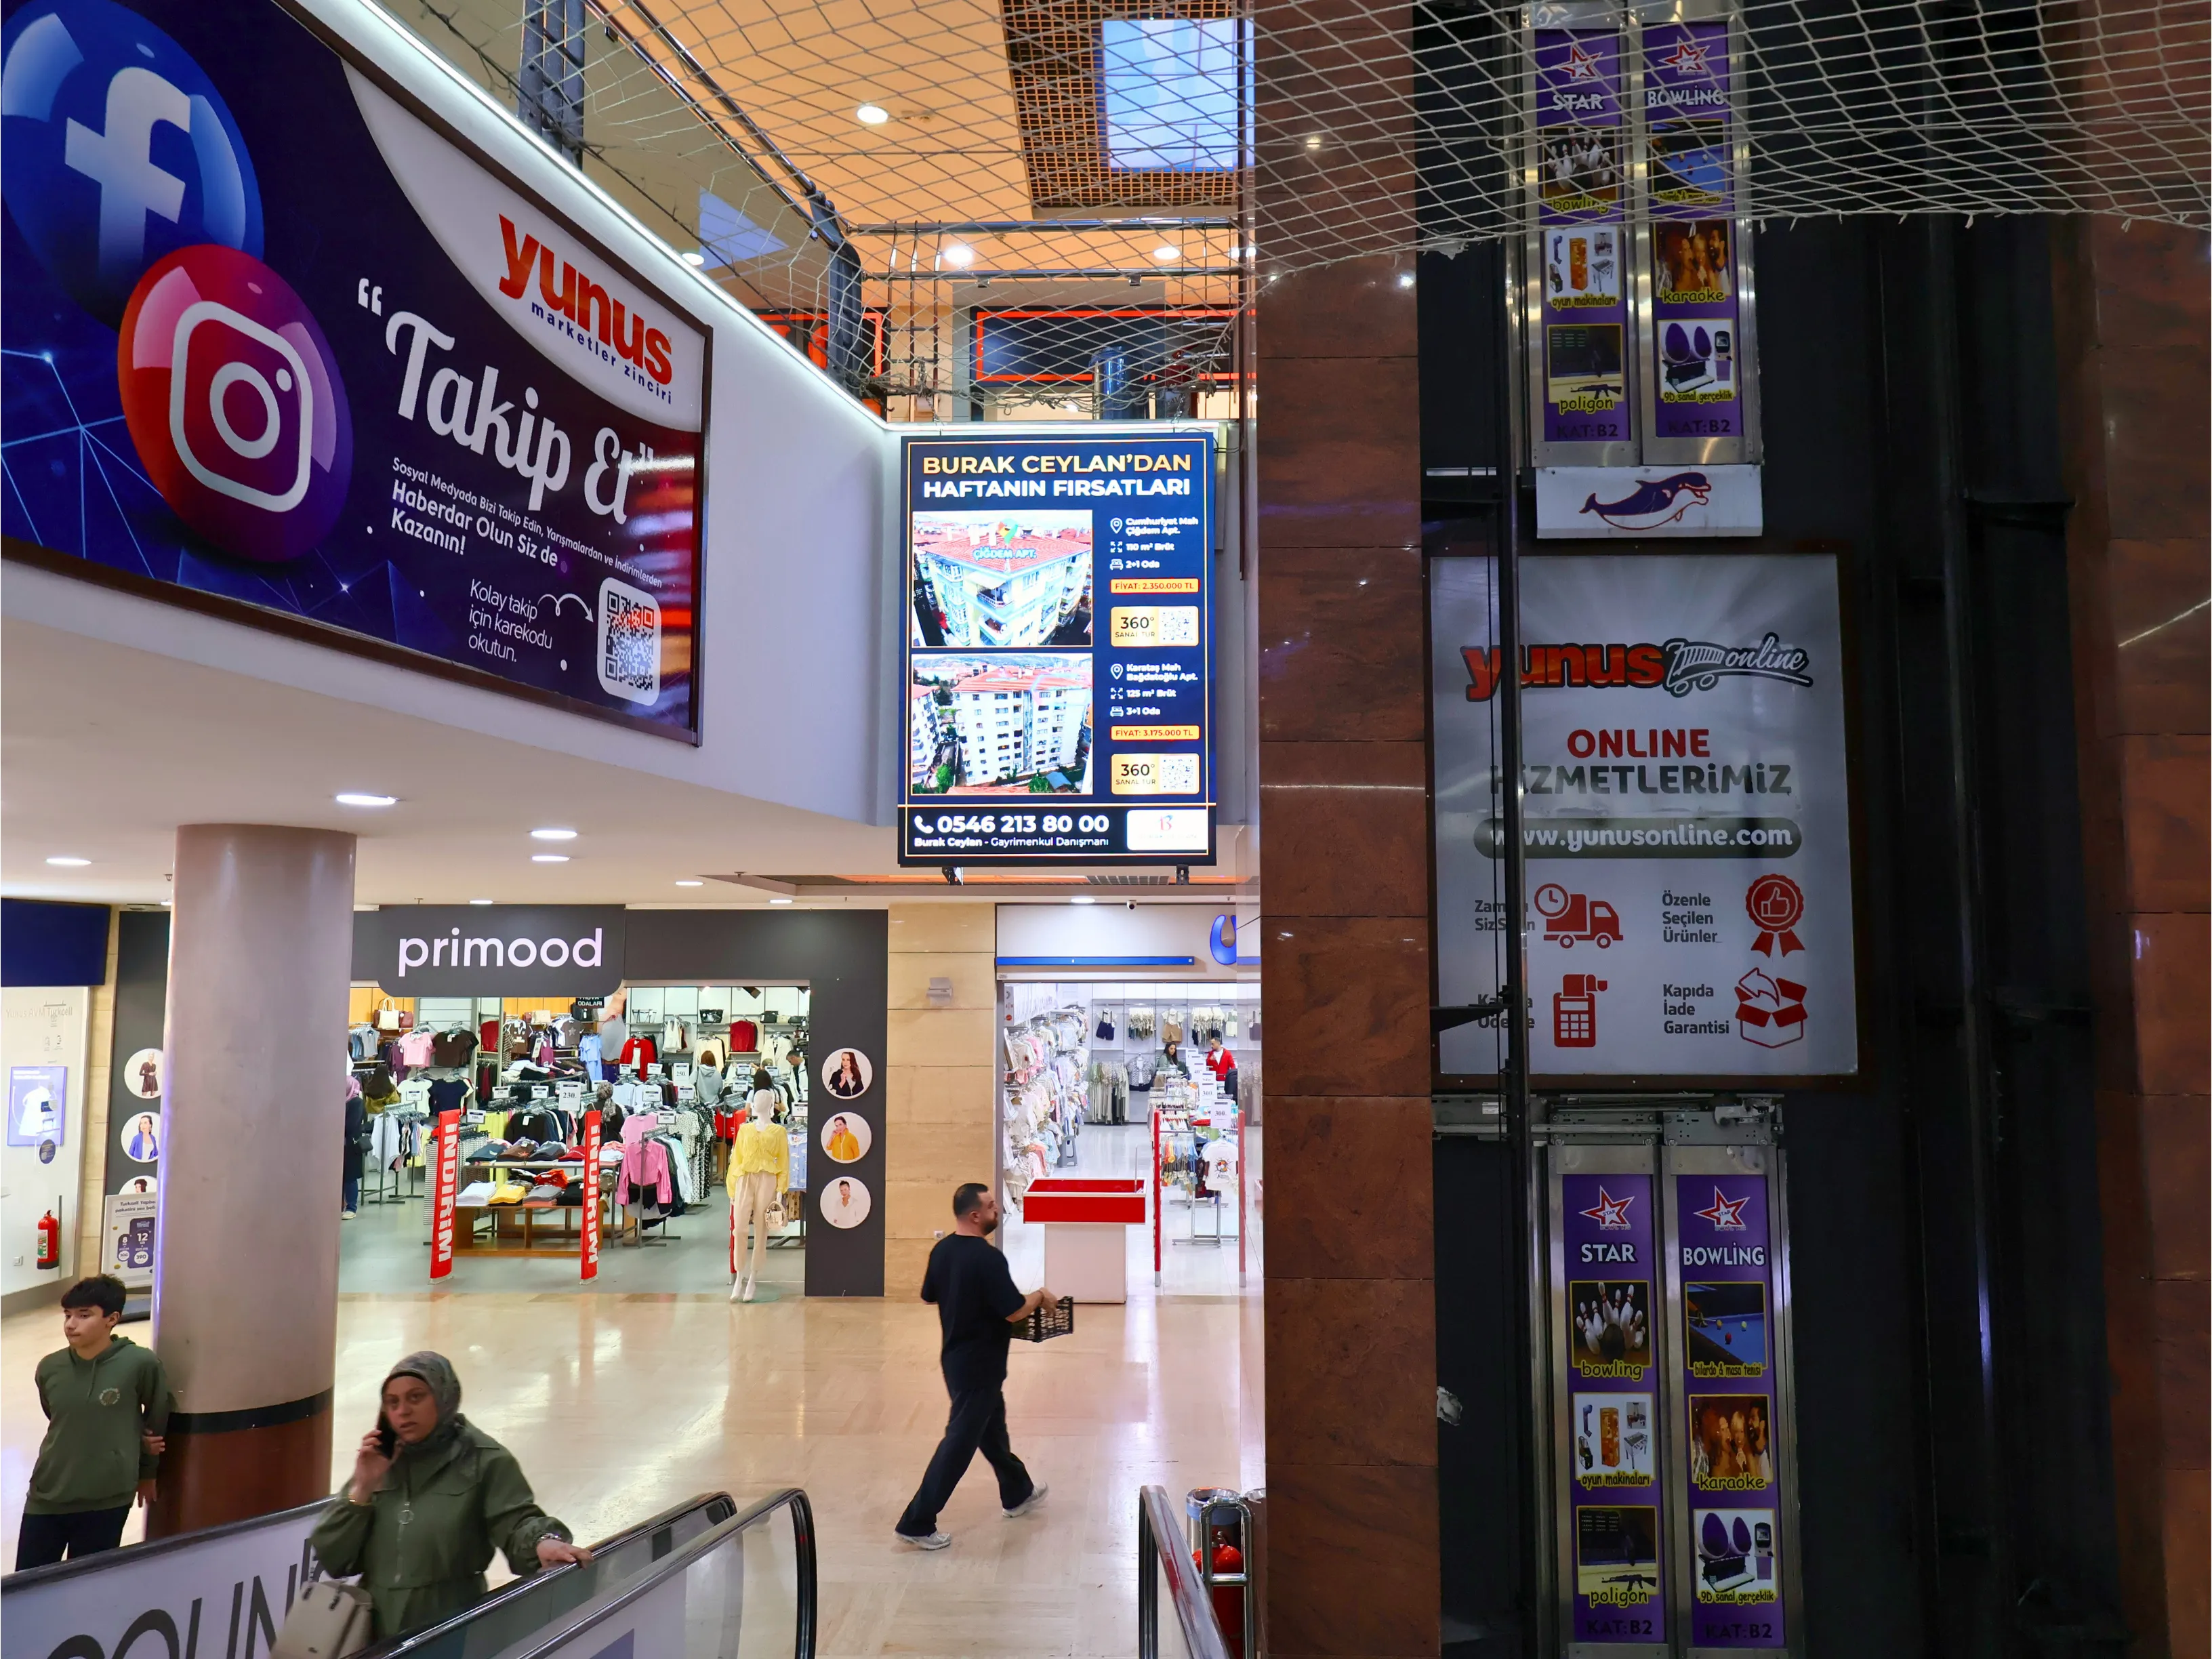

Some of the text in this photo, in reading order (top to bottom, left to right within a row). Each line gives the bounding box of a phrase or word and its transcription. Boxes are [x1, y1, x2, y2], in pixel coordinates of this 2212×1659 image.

[1553, 94, 1603, 110] STAR
[499, 213, 672, 385] yunus
[1552, 298, 1571, 310] oyun
[1663, 289, 1725, 303] karaoke
[532, 301, 672, 405] marketler zinciri
[1560, 396, 1614, 413] poligon
[1678, 392, 1696, 401] sanal
[1699, 390, 1733, 403] gerçeklik
[923, 455, 1015, 474] BURAK
[924, 477, 1191, 497] HAFTANIN FIRSATLARI
[392, 457, 428, 485] Sosyal
[430, 474, 477, 506] Medyada
[480, 496, 497, 514] Bizi
[499, 504, 521, 527] Takip
[523, 515, 544, 537] Edin,
[546, 525, 602, 562] Yarışmalardan
[604, 554, 613, 567] ve
[1179, 516, 1199, 525] Mah
[392, 478, 558, 567] Haberdar Olun Siz de
[391, 507, 466, 556] Kazanın!
[1126, 543, 1139, 551] 110
[1126, 560, 1160, 569] 2+1 Oda
[470, 578, 537, 623] Kolay takip
[469, 603, 552, 649] için karekodu
[468, 632, 517, 663] okutun.
[1162, 663, 1181, 672] Mah
[1461, 634, 1805, 701] yunus online
[1126, 689, 1141, 697] 125
[1126, 707, 1160, 716] 3+1 Oda
[1567, 729, 1711, 758] ONLINE
[937, 815, 1109, 833] 0546 213 80 00
[914, 838, 945, 847] Burak
[947, 838, 983, 848] Ceylan
[991, 837, 1053, 848] Gayrimenkul
[1056, 837, 1109, 848] Danışmanı
[1662, 890, 1711, 907] Özenle
[1662, 911, 1713, 928] Seçilen
[1662, 928, 1718, 943] Ürünler
[398, 927, 602, 977] primood
[1662, 984, 1714, 1001] Kapıda
[1663, 1000, 1696, 1017] İade
[1663, 1019, 1729, 1036] Garantisi
[137, 1233, 148, 1242] 12
[1581, 1244, 1636, 1263] STAR
[1582, 1361, 1642, 1380] bowling
[1582, 1473, 1650, 1489] oyun makinaları
[1699, 1475, 1765, 1490] karaoke
[1591, 1587, 1647, 1607] poligon
[1701, 1590, 1774, 1604] 9D sanal gerçeklik
